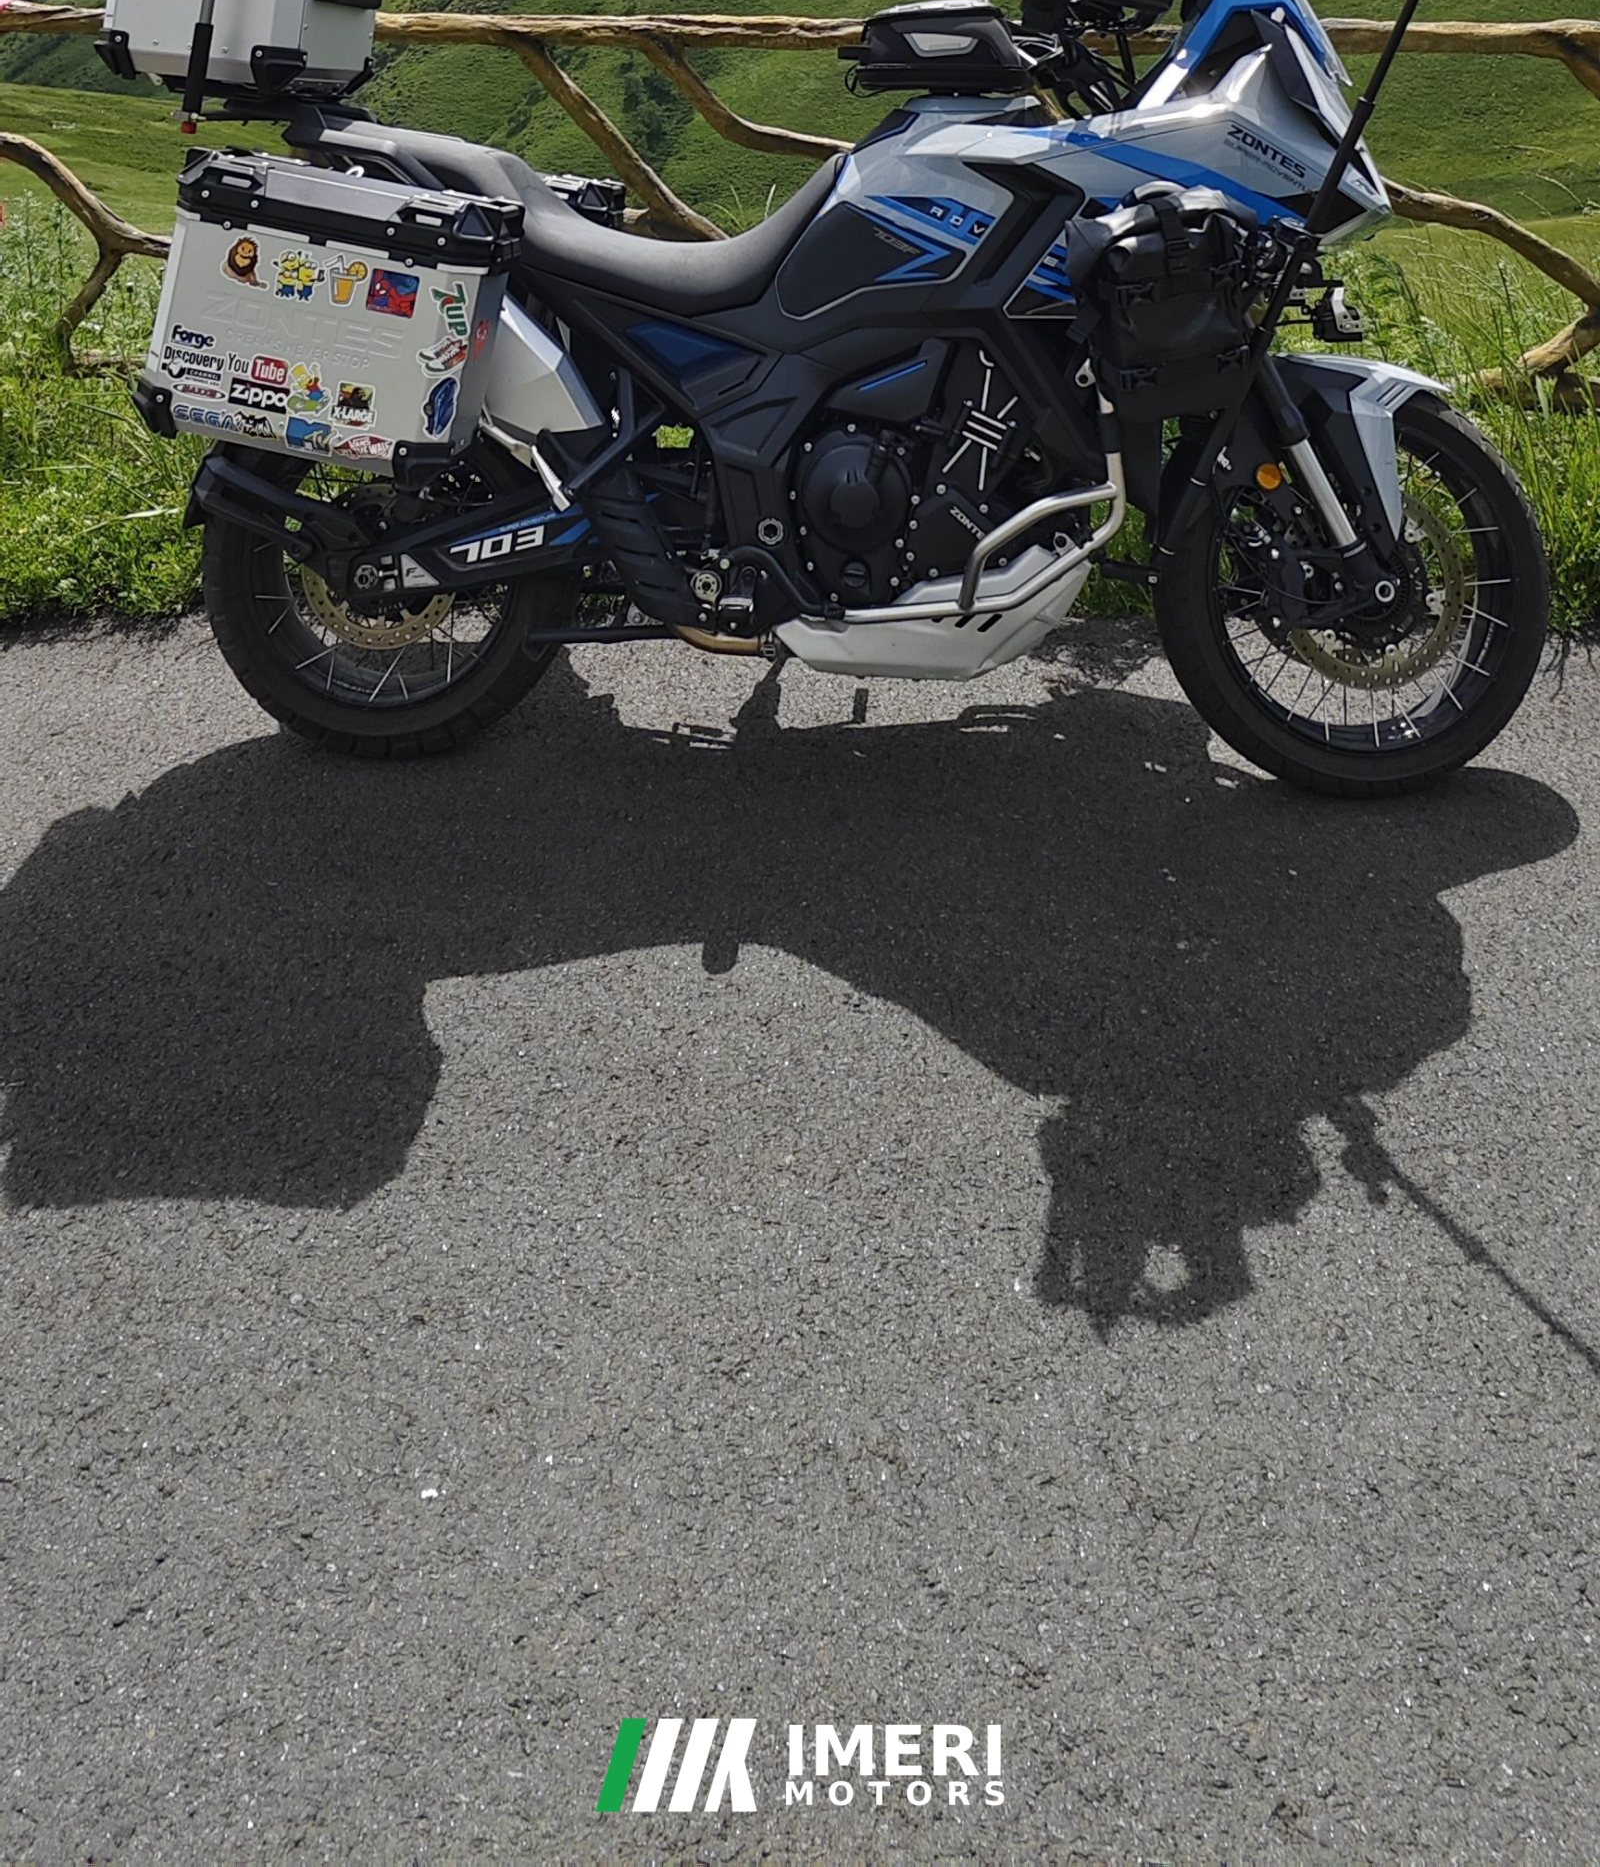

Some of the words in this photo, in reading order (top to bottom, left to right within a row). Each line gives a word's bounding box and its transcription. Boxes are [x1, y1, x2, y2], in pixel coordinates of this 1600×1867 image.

[1227, 124, 1307, 179] ZONTES
[200, 291, 404, 359] ZONTES
[173, 404, 240, 432] SEGA
[949, 505, 986, 541] ZONTE
[450, 525, 544, 563] 703
